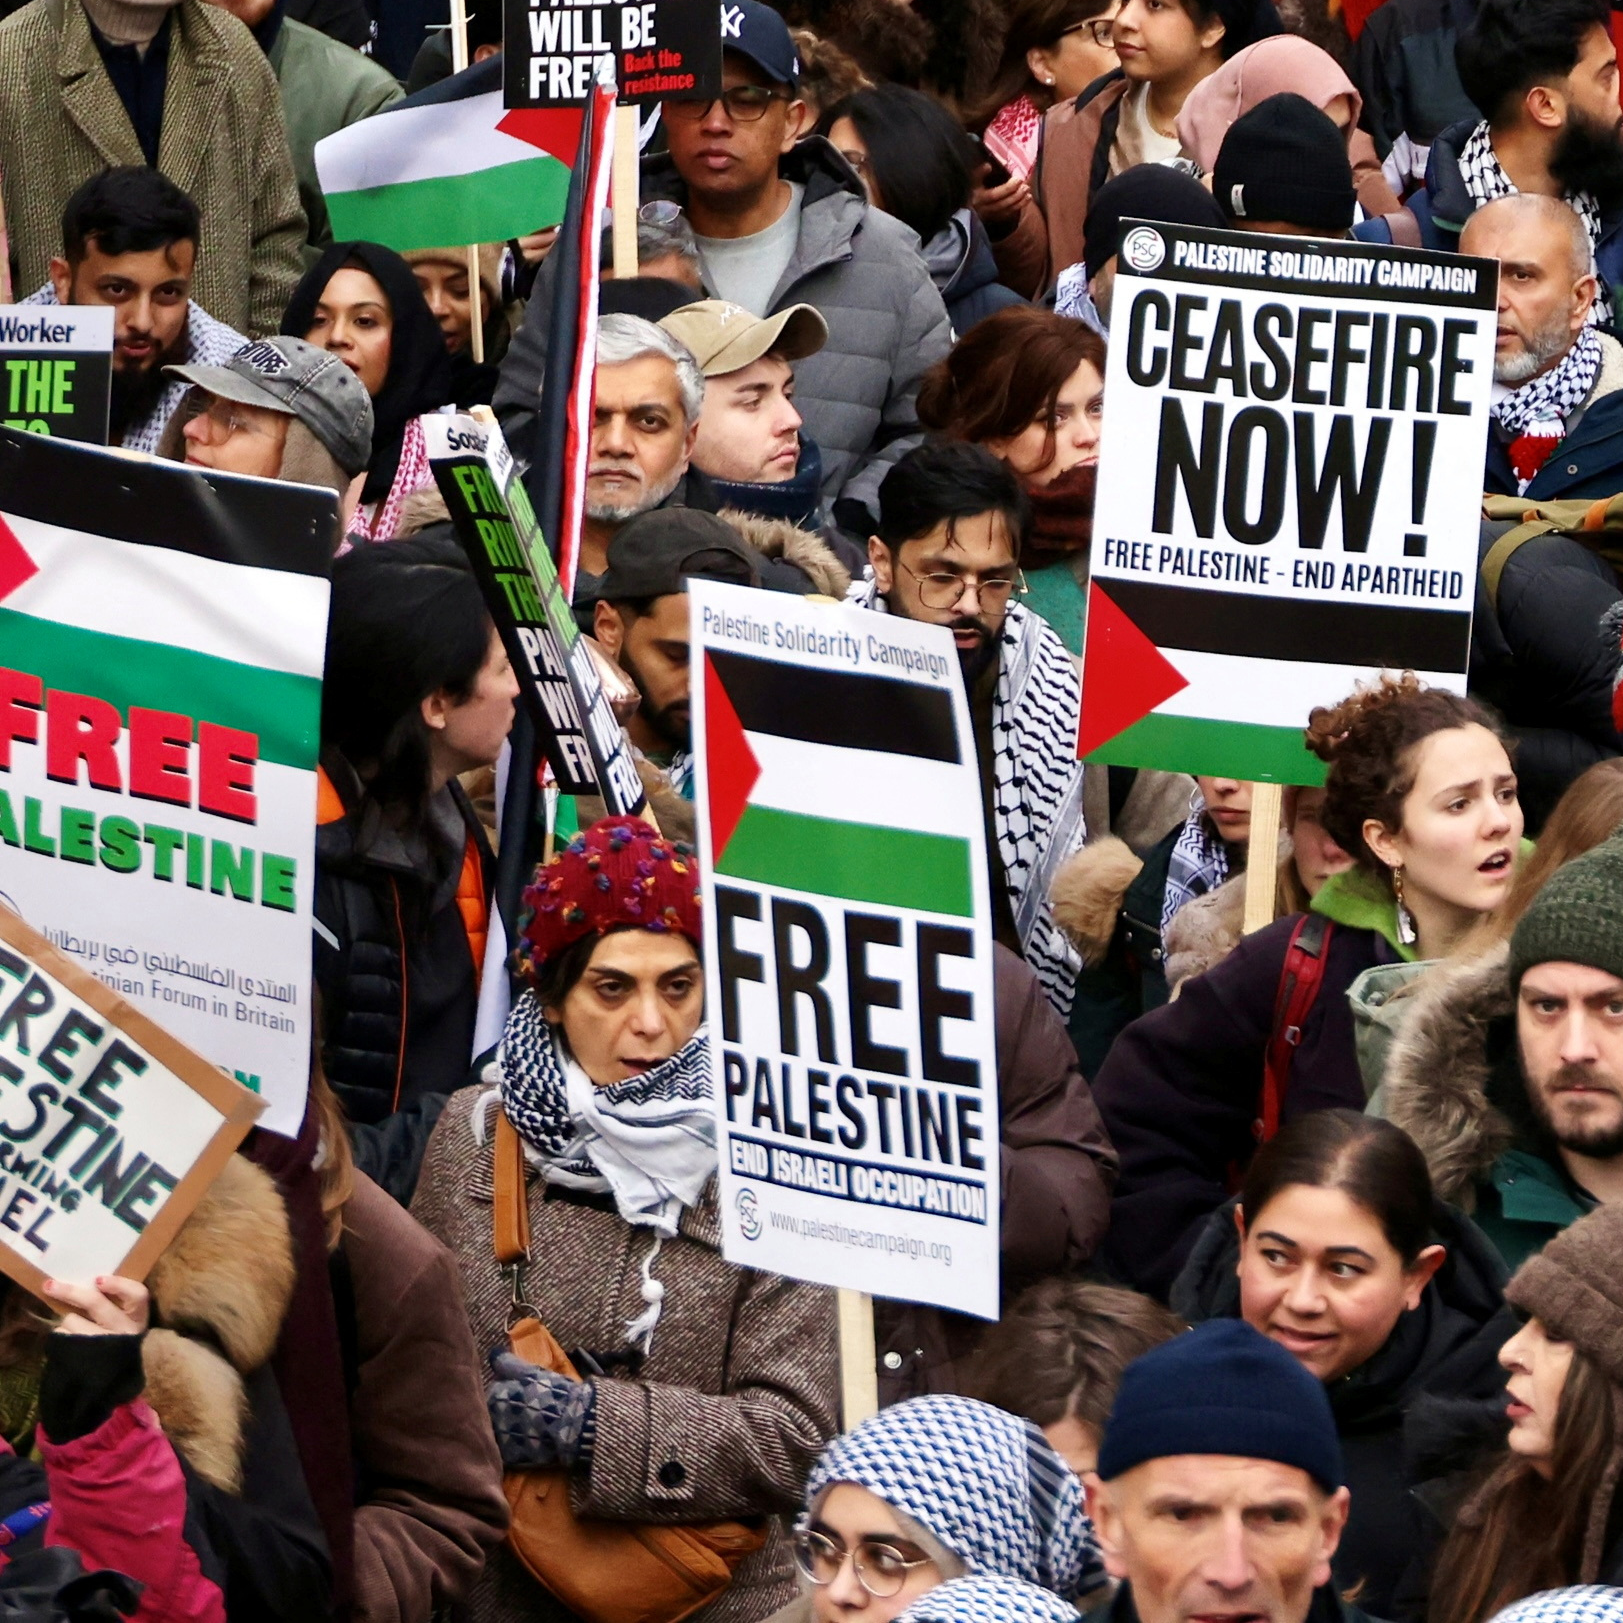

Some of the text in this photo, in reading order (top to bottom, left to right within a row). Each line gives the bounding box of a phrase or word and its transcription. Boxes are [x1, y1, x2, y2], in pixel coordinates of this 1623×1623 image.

[528, 3, 656, 53] WILL BE
[624, 49, 682, 73] Back the
[624, 72, 695, 95] resistance
[1174, 240, 1477, 294] PALESTINE SOLIDARITY CAMPAIGN
[1126, 288, 1478, 416] CEASEFIRE
[1151, 396, 1438, 558] NOW!
[1104, 538, 1463, 599] FREE PALESTINE END APARTHEID
[715, 884, 981, 1089] FREE
[724, 1049, 986, 1171] PALESTINE
[732, 1137, 985, 1224] END ISRAELI OCCUPATION
